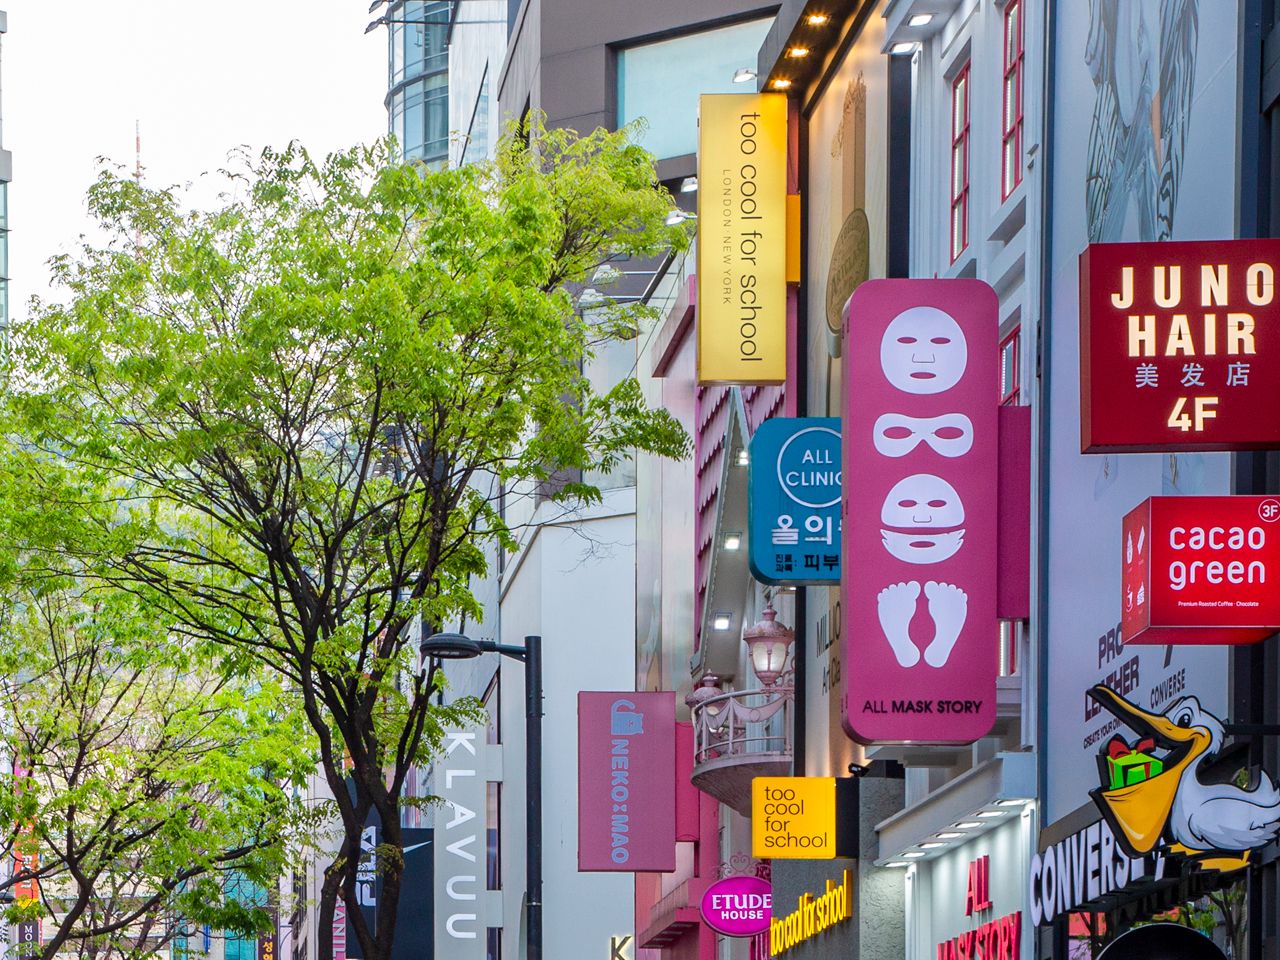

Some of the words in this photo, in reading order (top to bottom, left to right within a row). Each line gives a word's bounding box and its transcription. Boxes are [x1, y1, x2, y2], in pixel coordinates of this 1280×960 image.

[740, 112, 761, 155] too
[723, 170, 731, 227] LONDON
[740, 165, 762, 219] cool
[723, 236, 732, 264] NEW
[740, 230, 762, 265] for
[723, 269, 732, 304] YORK
[1111, 263, 1274, 309] JUNO
[740, 275, 762, 361] school
[1128, 313, 1256, 357] HAIR
[1135, 362, 1250, 388] 美发店
[1167, 397, 1219, 431] 4F
[802, 450, 832, 463] ALL
[1263, 505, 1279, 517] 3F
[771, 514, 842, 545] 올의
[1170, 527, 1266, 550] cacao
[1170, 561, 1266, 590] green
[1150, 668, 1185, 709] CONVERSE
[863, 701, 887, 714] ALL
[892, 701, 933, 714] MASK
[937, 701, 982, 714] STORY
[764, 800, 804, 815] cool
[765, 786, 795, 801] too
[446, 732, 476, 939] KLAVUU
[764, 832, 827, 848] school
[765, 817, 790, 832] for
[966, 855, 992, 916] ALL
[712, 894, 772, 910] ETUDE
[721, 911, 763, 919] HOUSE
[770, 916, 784, 957] too
[785, 896, 803, 950] cool
[803, 892, 817, 940] for
[817, 869, 848, 933] school
